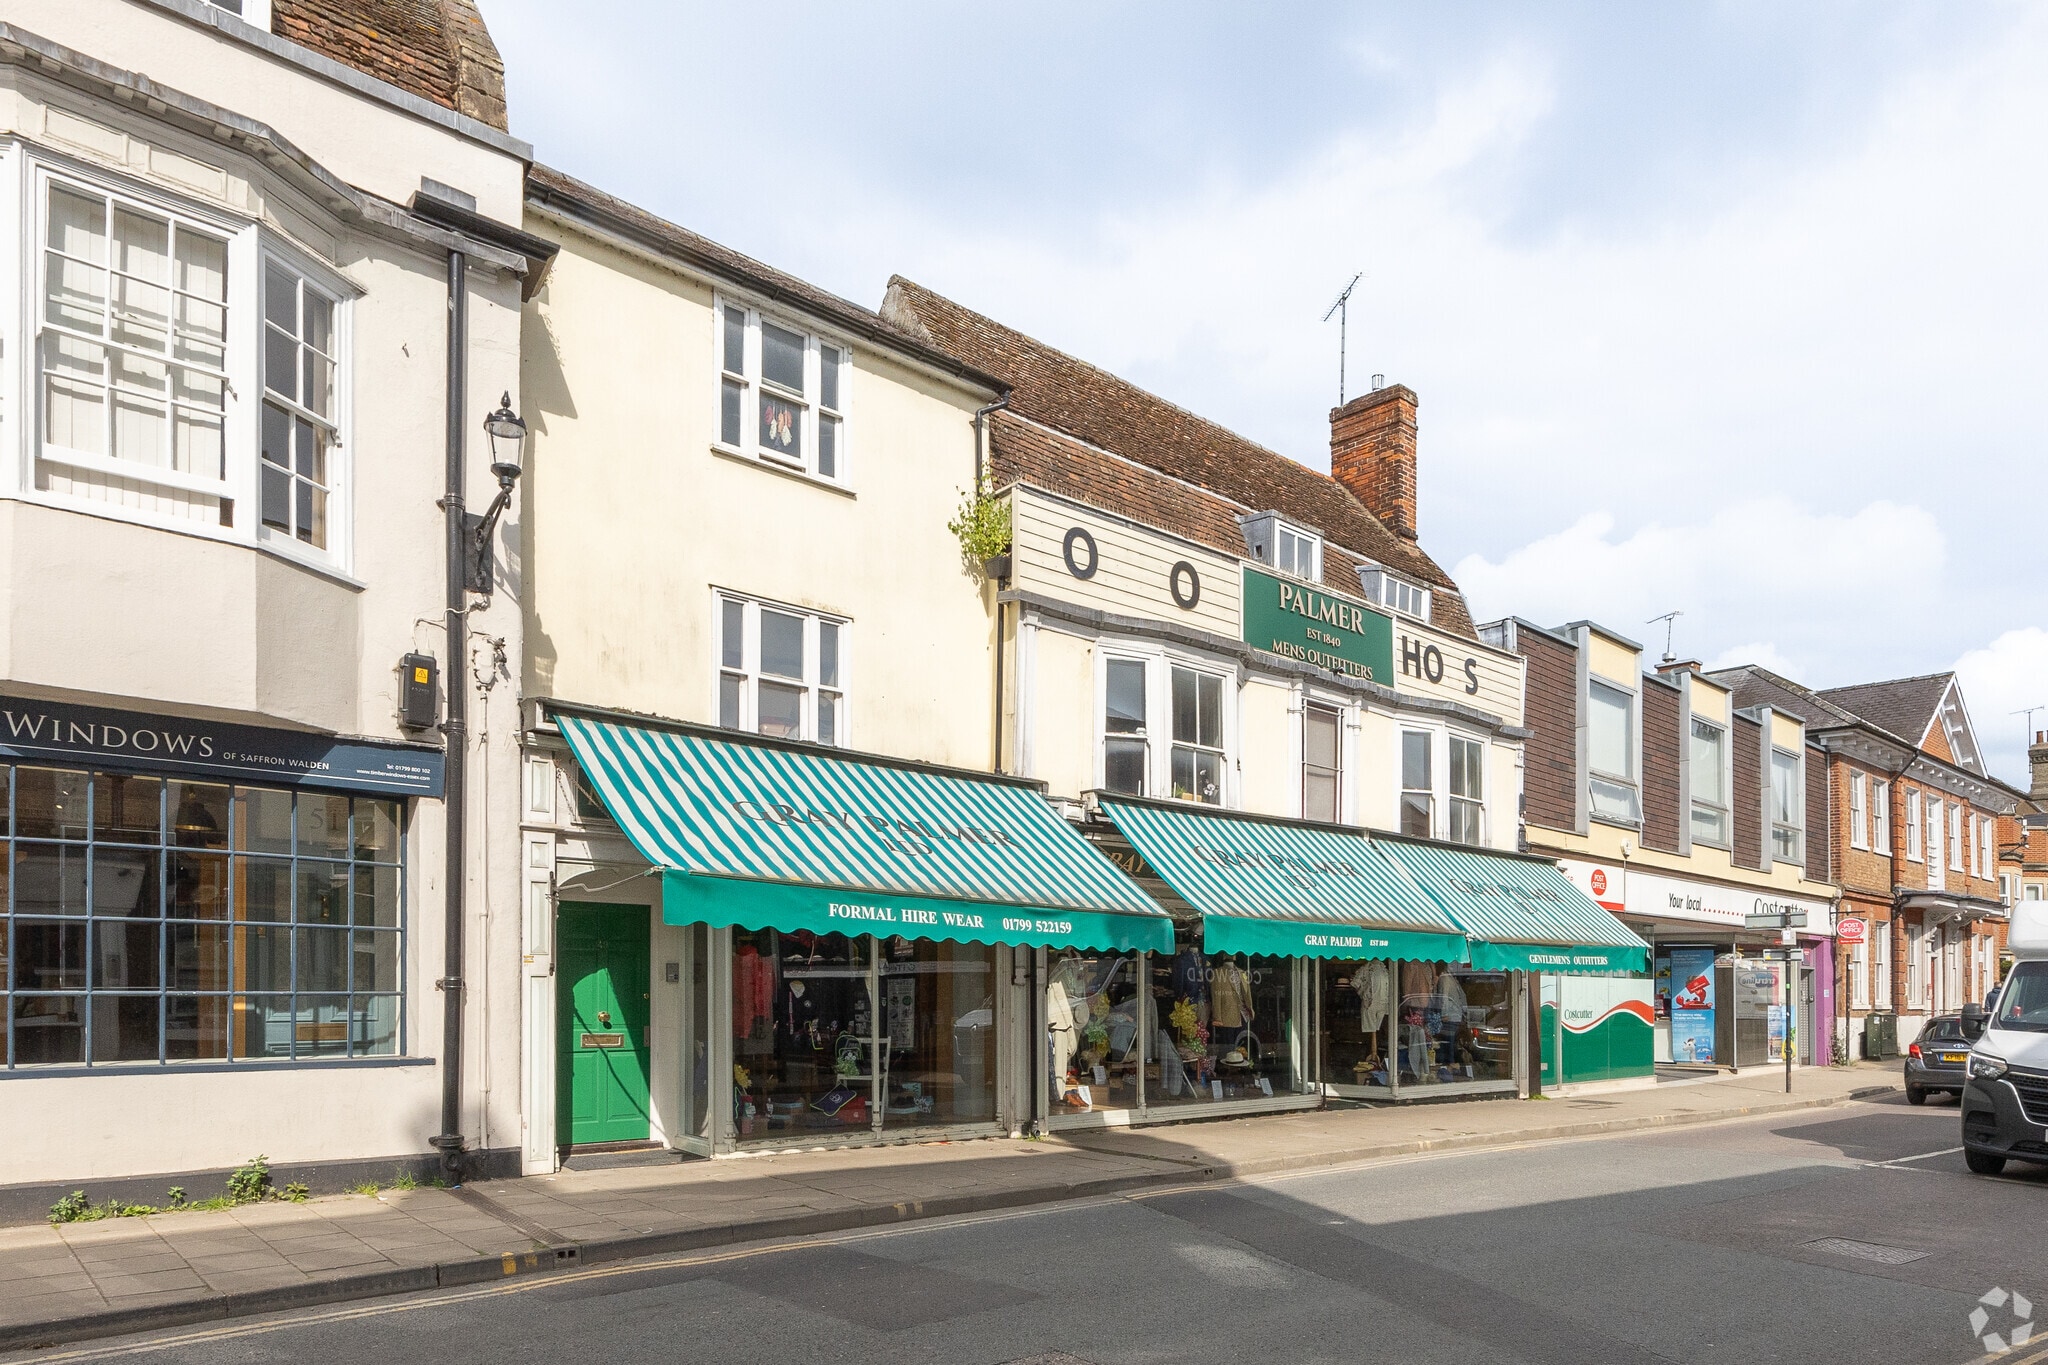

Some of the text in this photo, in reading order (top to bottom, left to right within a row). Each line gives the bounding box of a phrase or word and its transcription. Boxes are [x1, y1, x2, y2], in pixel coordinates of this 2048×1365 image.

[1279, 582, 1365, 635] PALMER
[1307, 627, 1341, 647] EST 1840
[1272, 638, 1373, 680] MENS OUTFITTERS
[3, 711, 330, 770] WINDOWS OF SAFFRON WALDEN
[733, 801, 1024, 848] GRAY PALMER
[882, 838, 933, 857] LTD
[1193, 845, 1367, 878] GRAY PALMER
[1592, 881, 1606, 889] OFFICE
[1594, 874, 1605, 882] POST
[1669, 893, 1683, 908] Your
[828, 903, 1072, 934] FORMAL HIRE WEAR 01799 522159
[1305, 934, 1328, 946] GRAY
[1330, 936, 1362, 947] PALMER
[1573, 956, 1608, 965] OUTFITTERS
[1564, 1009, 1593, 1020] Costcutter
